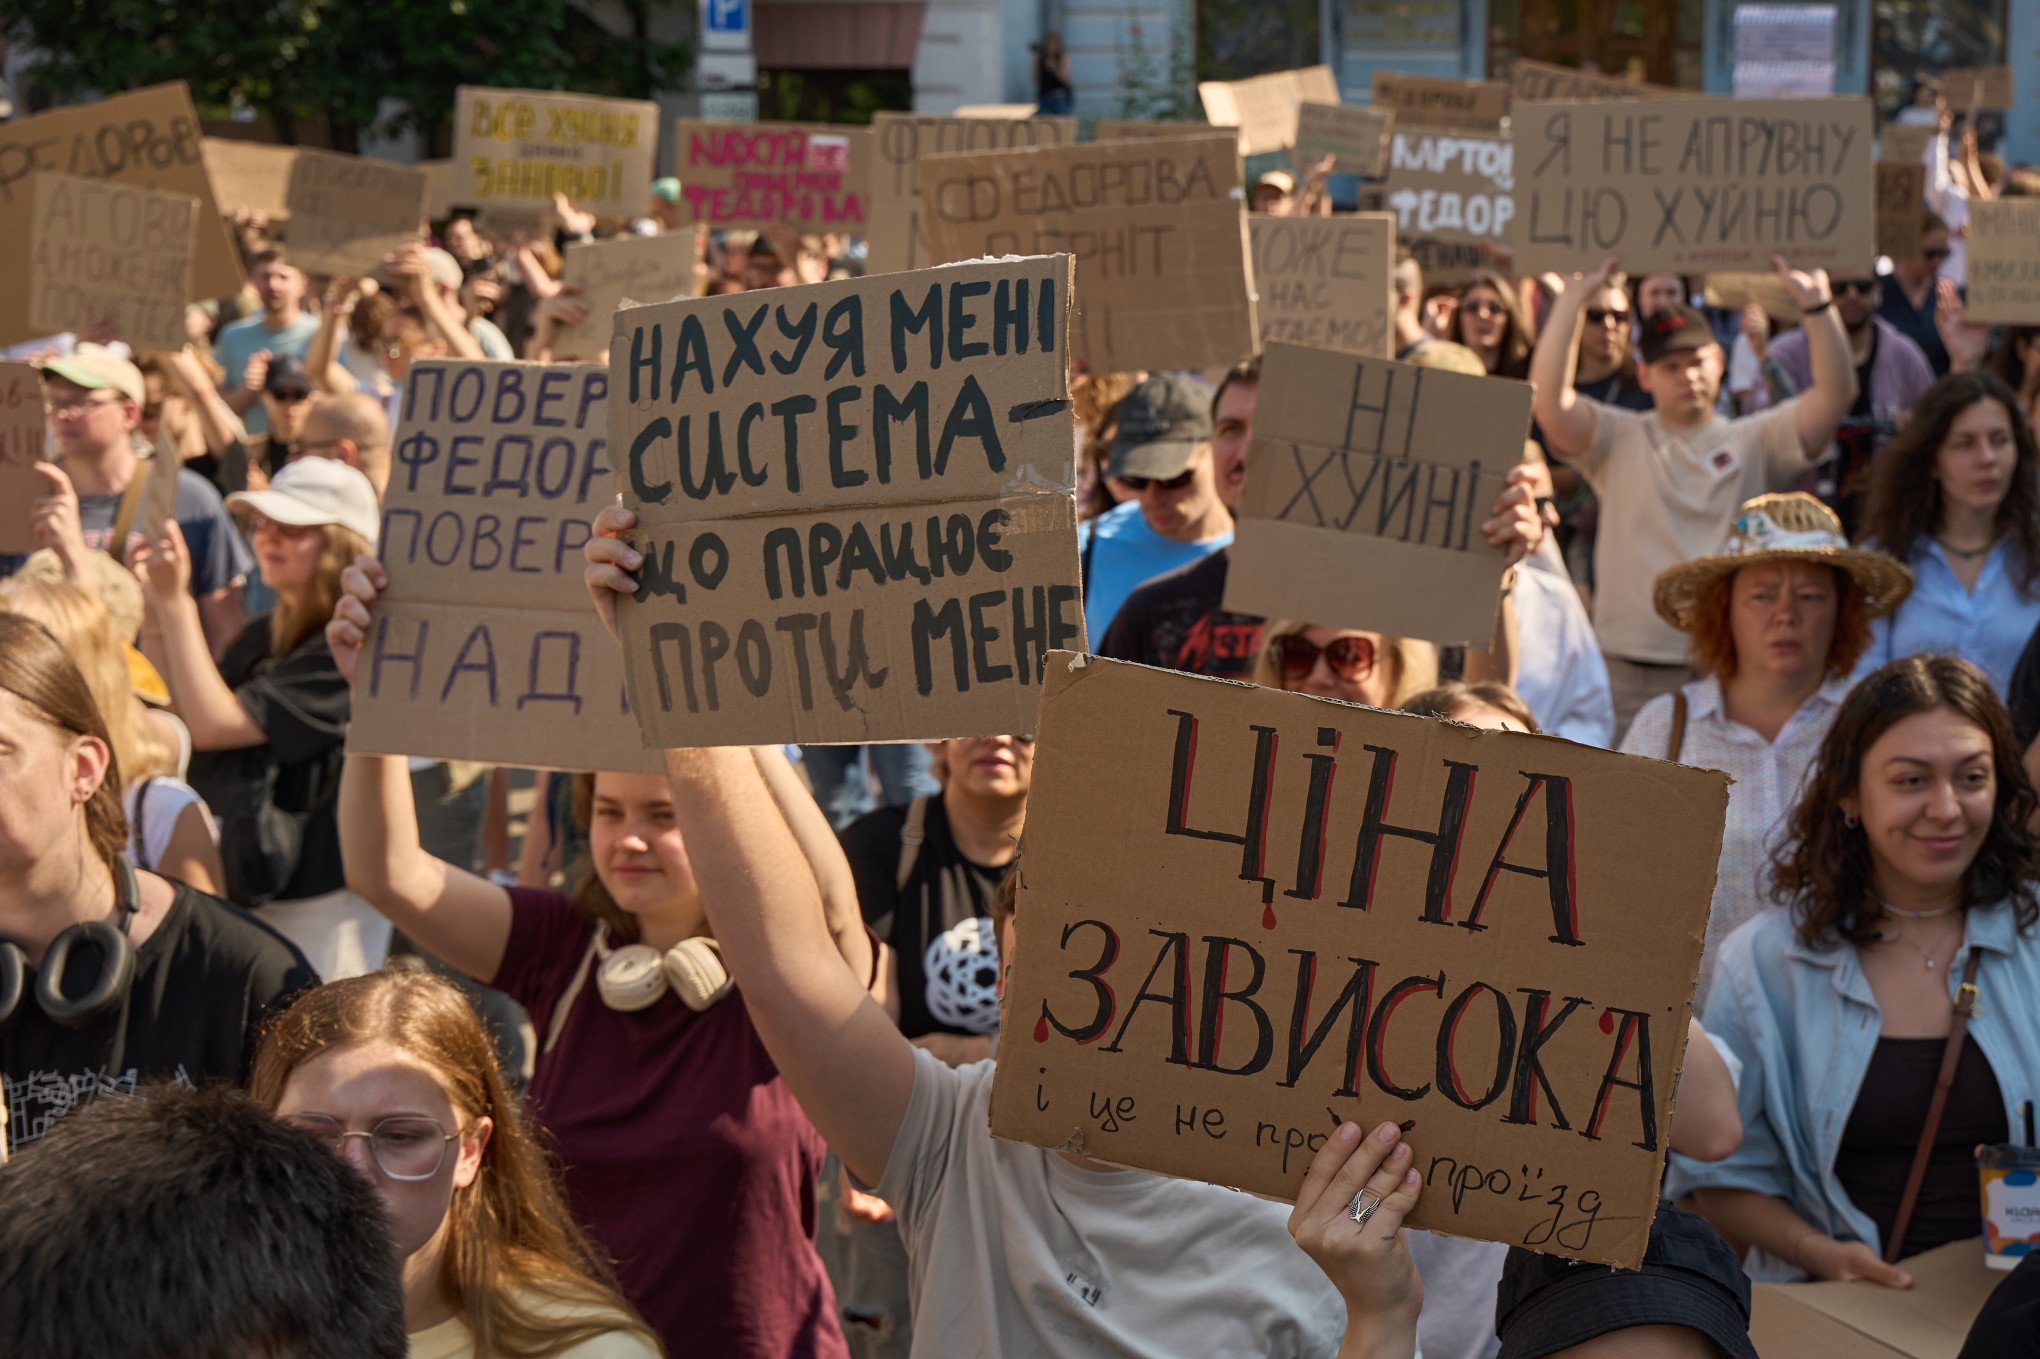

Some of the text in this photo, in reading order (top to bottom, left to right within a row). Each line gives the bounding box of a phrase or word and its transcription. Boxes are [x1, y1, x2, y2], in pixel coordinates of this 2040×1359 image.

[1533, 110, 1856, 178] Я НЕ АПРУВНУ
[936, 157, 1218, 225] ФЕДОРОВА
[1529, 186, 1628, 252] ЦЮ
[1652, 181, 1844, 248] ХУЙНЮ
[1252, 222, 1373, 280] ОЖЕ
[630, 295, 866, 403] НАХУЯ
[890, 278, 1055, 374] МЕНІ
[1267, 281, 1330, 312] НАС
[405, 367, 608, 429] ПОВЕР
[1344, 363, 1422, 459] НІ
[399, 431, 612, 503] ФЕДОР
[1277, 446, 1481, 551] ХУЙНІ
[378, 509, 592, 573] ПОВЕР
[764, 509, 1013, 599] ПРАЦЮЄ
[369, 615, 630, 715] НАД
[650, 585, 1080, 713] ПРОТИ МЕНЕ
[1165, 708, 1585, 946] ЦІНА
[1038, 920, 1659, 1152] ЗАВИСОКА
[1090, 1090, 1138, 1132] це
[1175, 1104, 1228, 1140] не
[1426, 1155, 1640, 1250] проїзд
